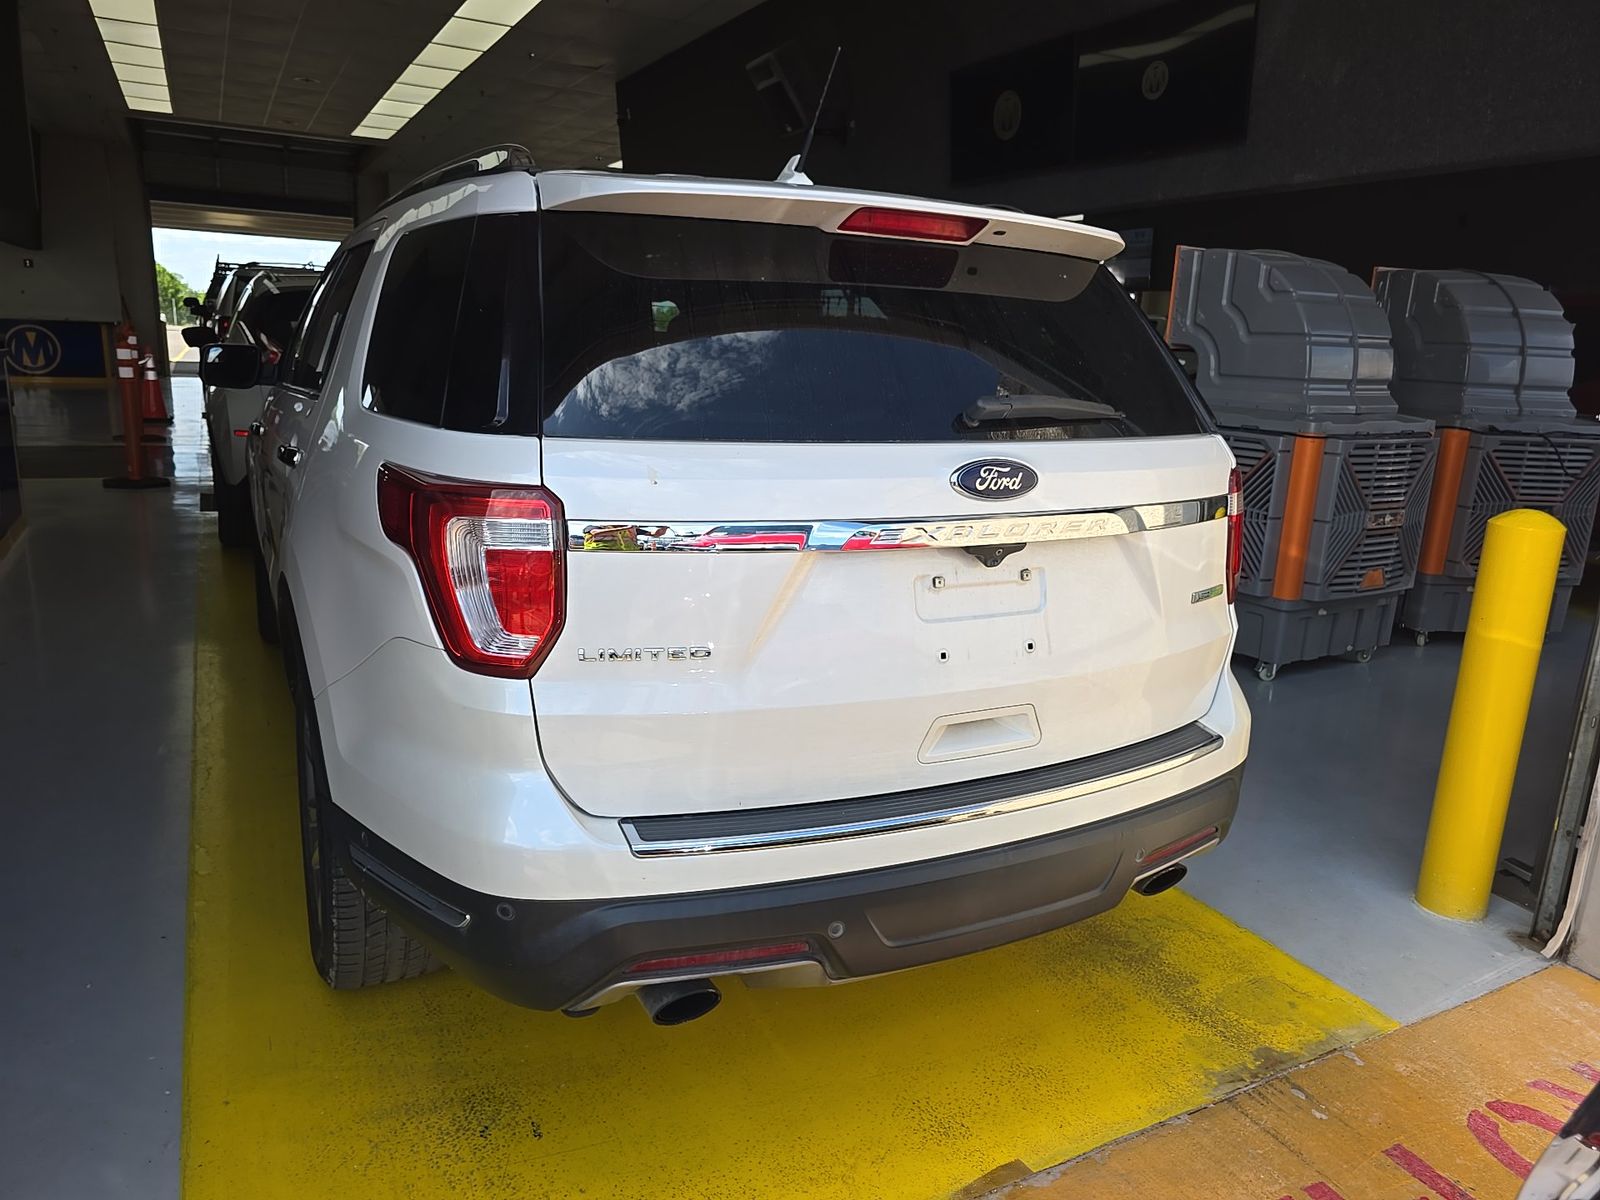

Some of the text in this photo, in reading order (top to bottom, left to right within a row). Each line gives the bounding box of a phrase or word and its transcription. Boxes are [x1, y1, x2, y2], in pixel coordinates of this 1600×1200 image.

[975, 465, 1023, 491] Ford
[870, 516, 1109, 545] EXPLORER
[577, 646, 713, 663] LIMITED
